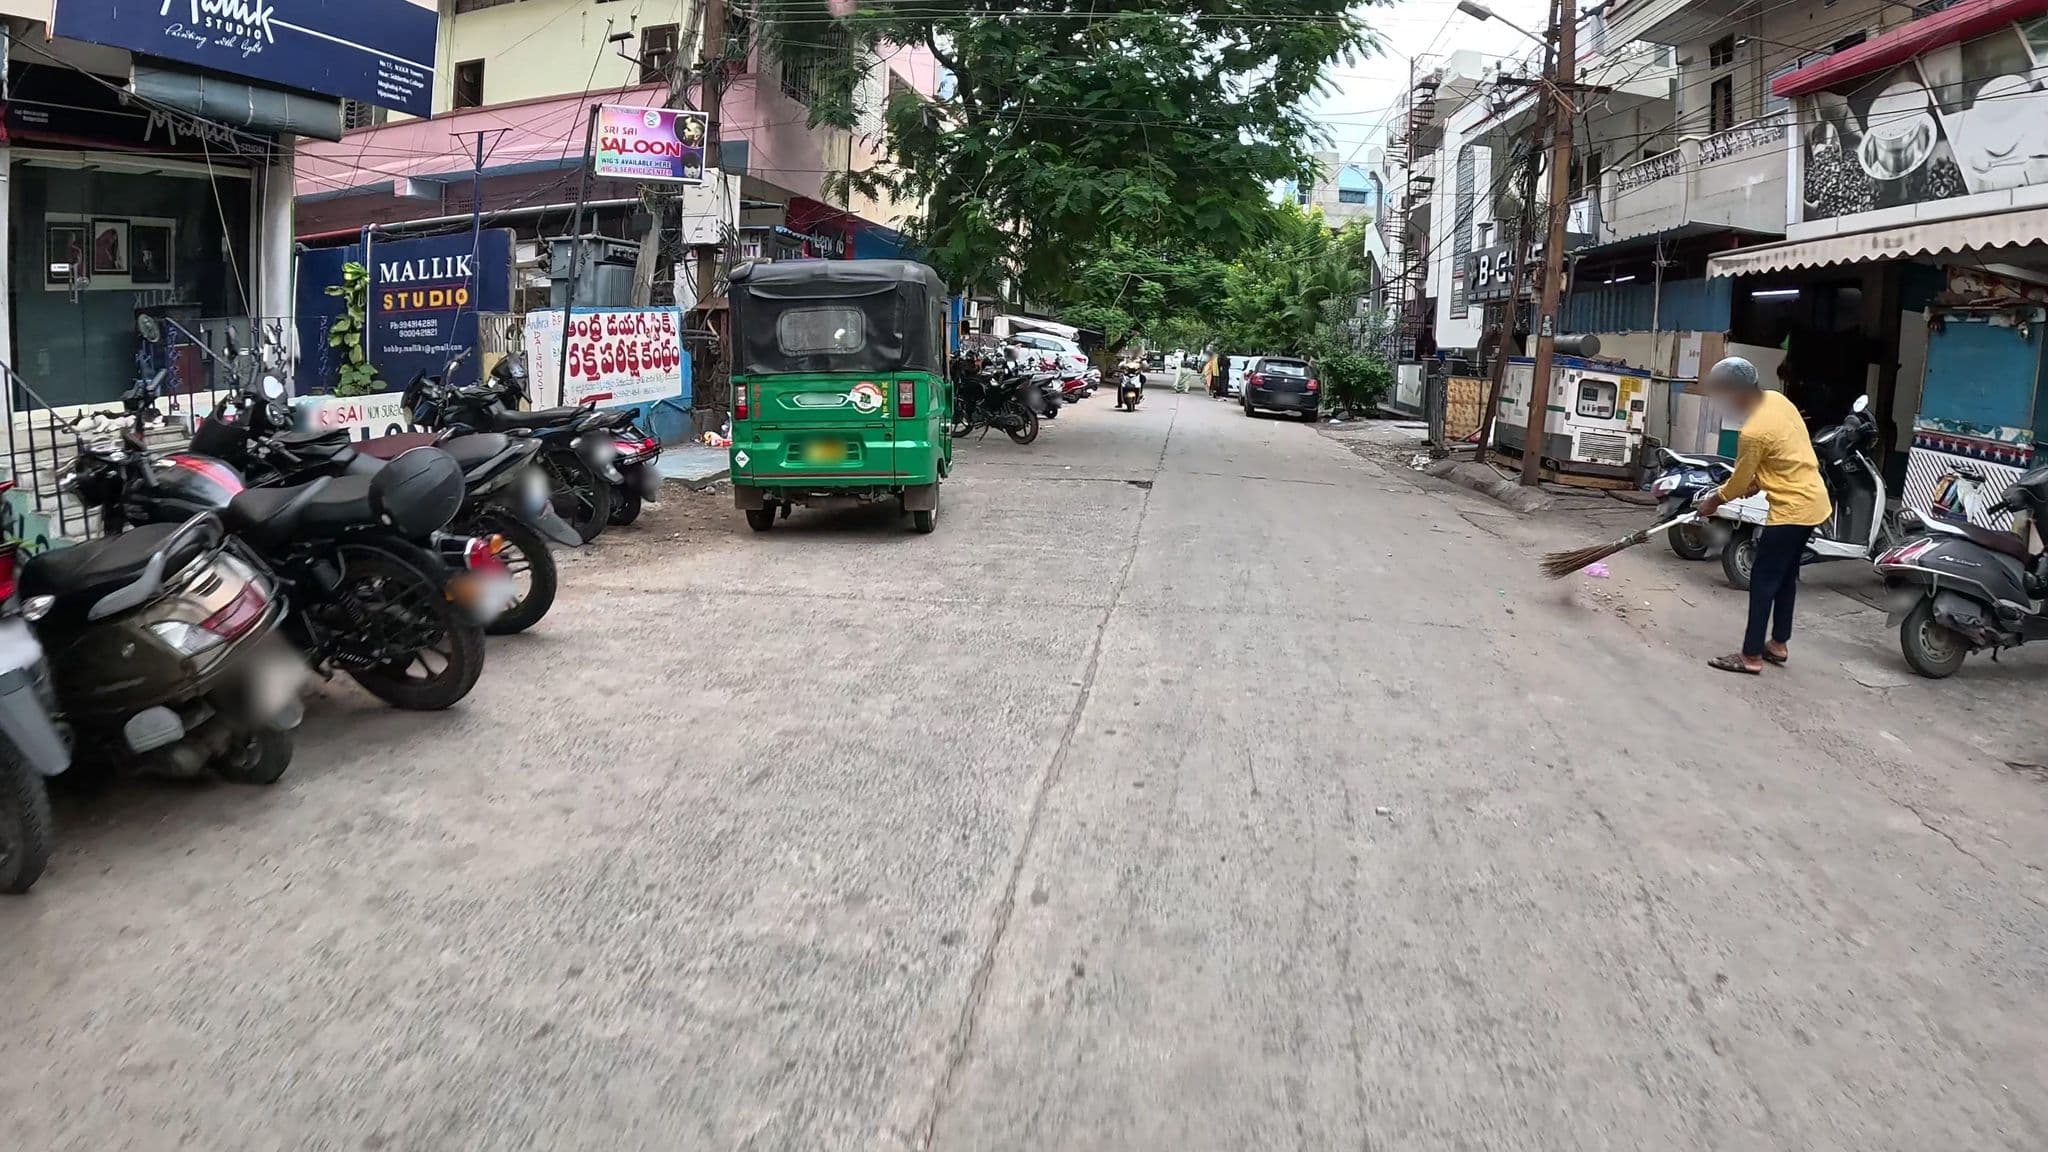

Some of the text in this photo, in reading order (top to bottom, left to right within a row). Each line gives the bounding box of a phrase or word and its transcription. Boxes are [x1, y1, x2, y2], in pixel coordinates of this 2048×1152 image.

[205, 16, 262, 40] STUDIO
[144, 111, 240, 155] Mallik
[604, 125, 637, 136] SRI SAI
[601, 137, 680, 156] SALOON
[621, 159, 653, 167] AVAILABLE
[379, 254, 473, 284] MALLIK
[382, 288, 469, 311] STUDIO
[336, 405, 363, 424] SAI
